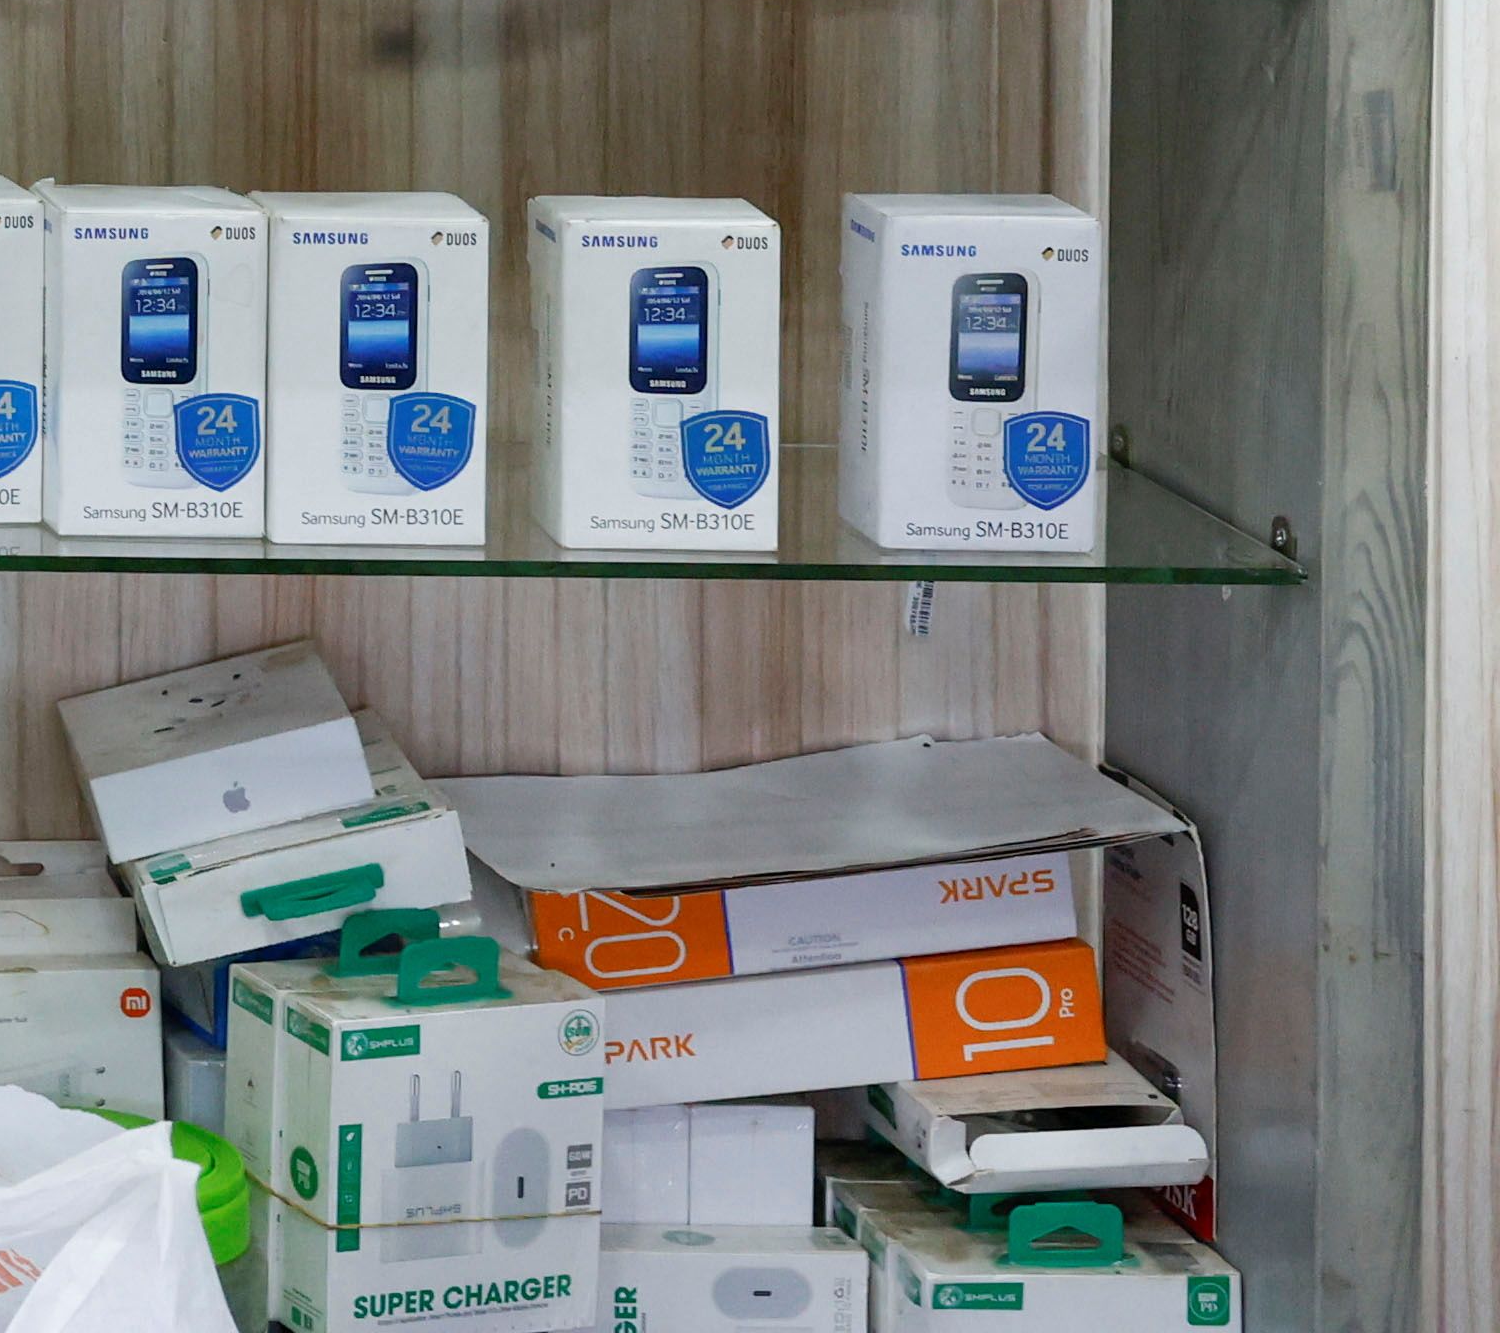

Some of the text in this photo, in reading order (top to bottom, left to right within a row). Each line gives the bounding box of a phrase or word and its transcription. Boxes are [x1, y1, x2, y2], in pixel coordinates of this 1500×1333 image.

[4, 215, 34, 229] DUOS
[900, 245, 1088, 263] SAMSUNG DUOS
[134, 297, 176, 314] 12:34
[906, 521, 1068, 541] Samsung SM-B310E
[939, 869, 1054, 903] SPARK
[962, 967, 1076, 1061] 10 Pro
[568, 1187, 588, 1201] PD
[354, 1289, 434, 1319] SUPER
[442, 1274, 572, 1309] CHARGER
